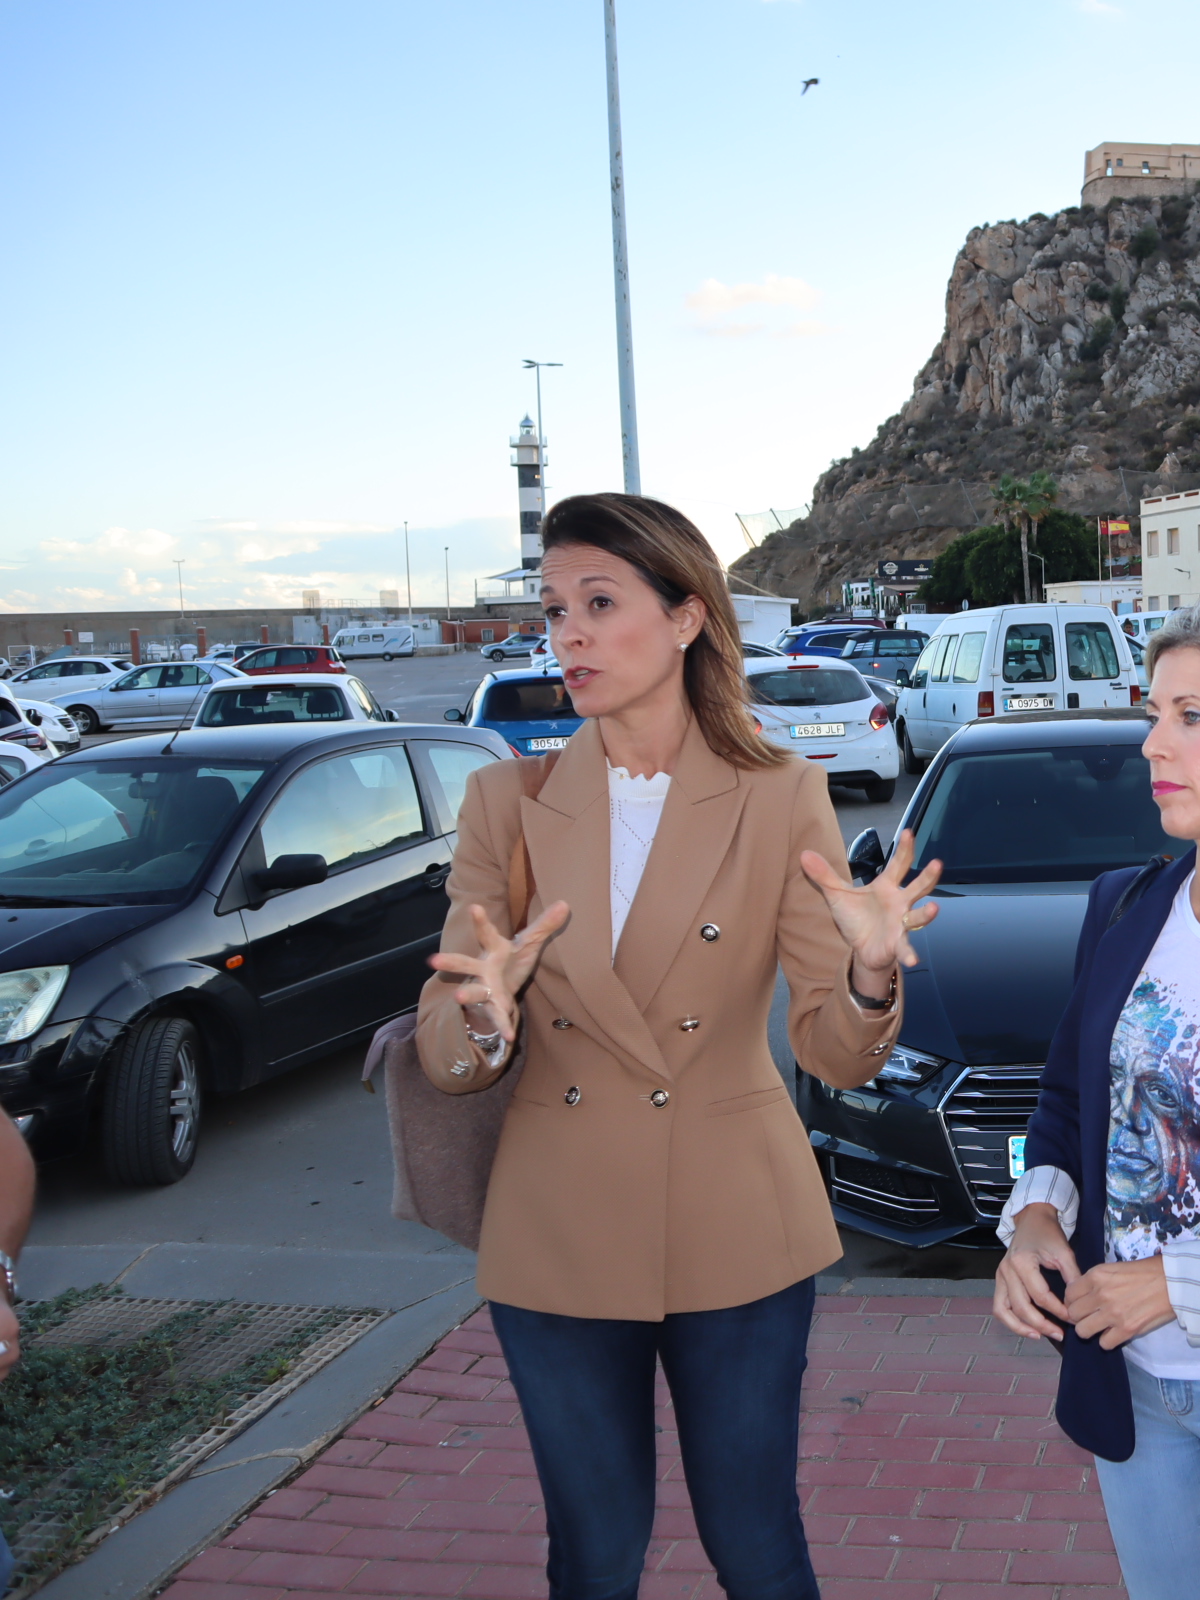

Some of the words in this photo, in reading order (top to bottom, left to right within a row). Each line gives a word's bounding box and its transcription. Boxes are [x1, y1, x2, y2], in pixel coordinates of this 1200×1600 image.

[1008, 700, 1014, 709] A
[1017, 699, 1039, 708] 0975
[797, 725, 822, 736] 4628
[825, 724, 842, 735] JLF
[533, 739, 560, 749] 3054
